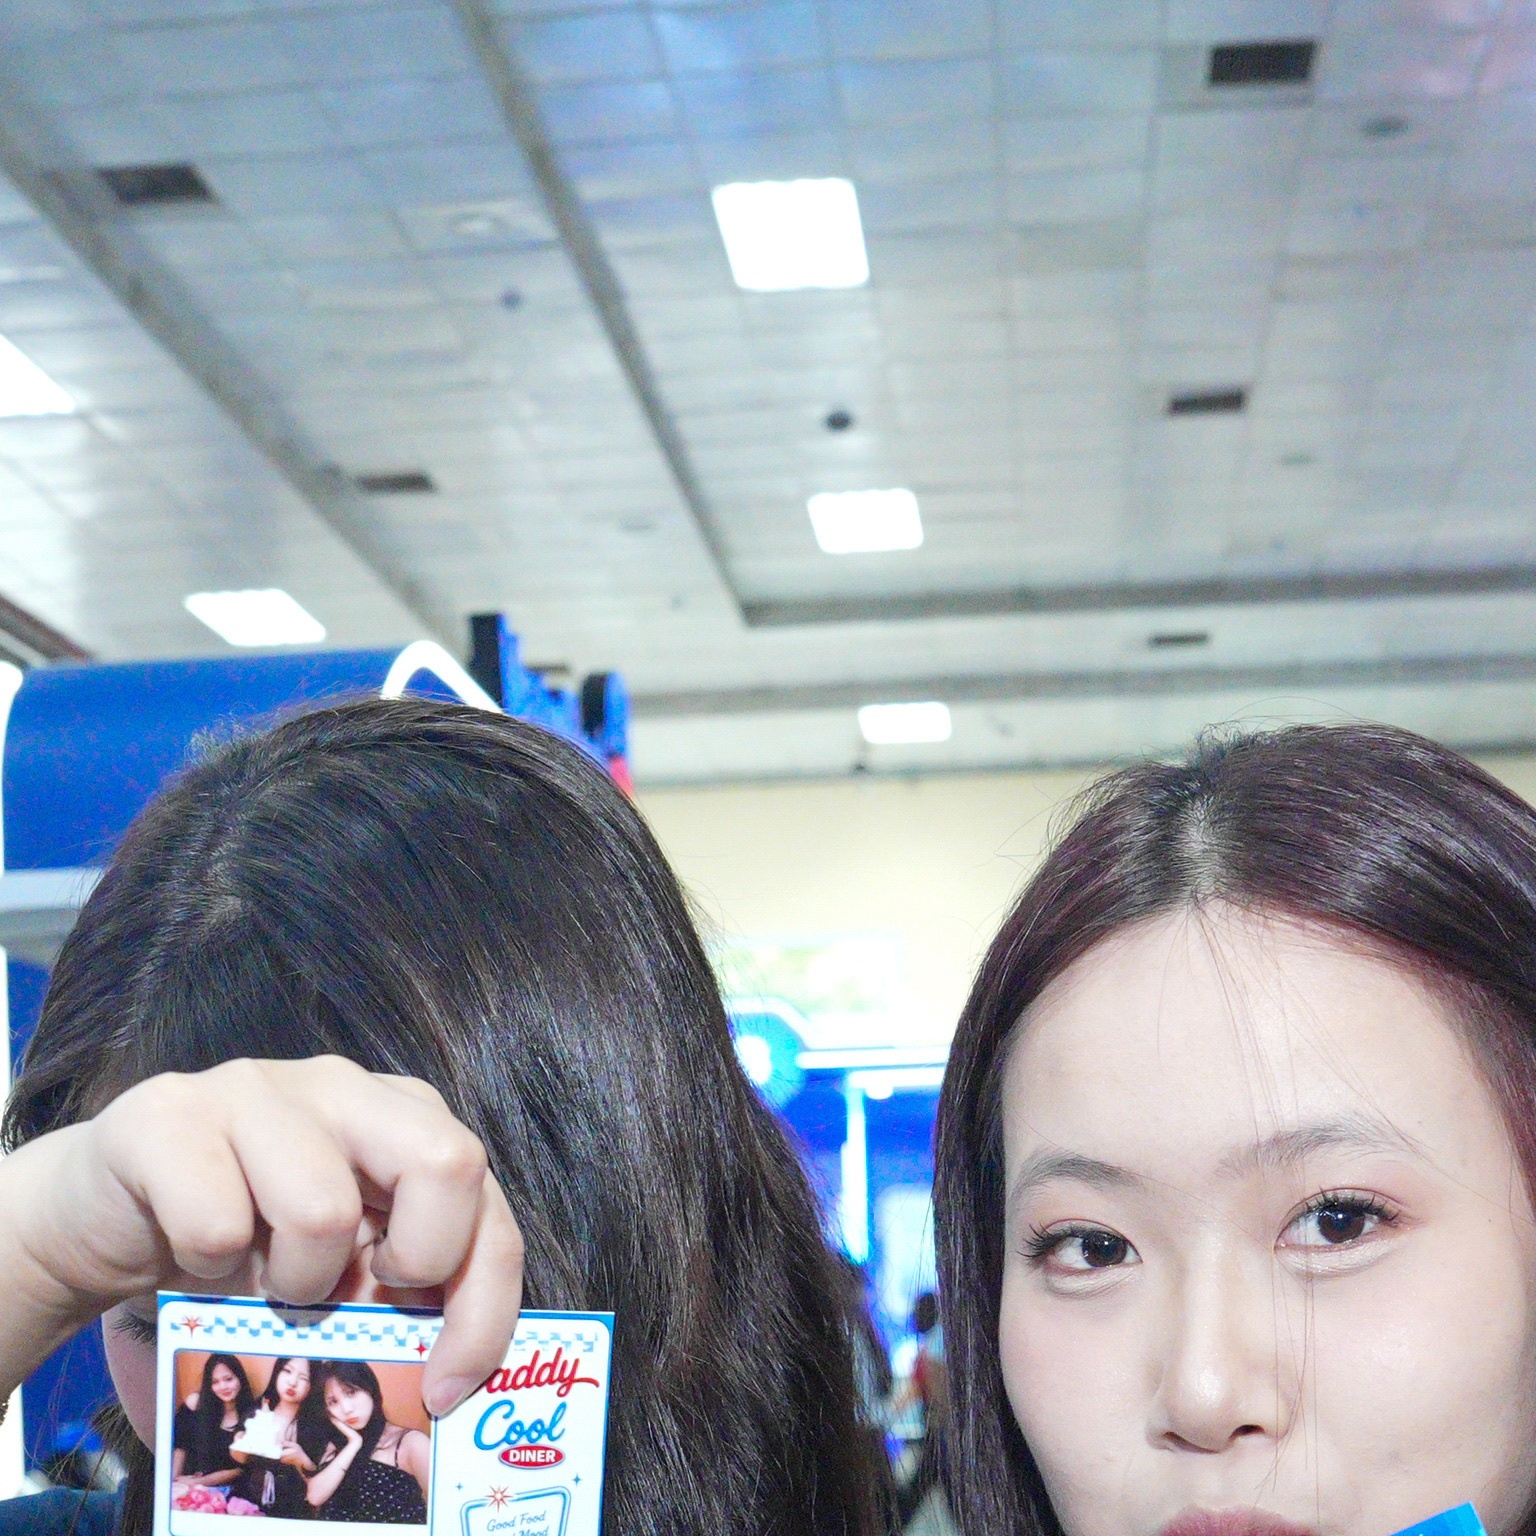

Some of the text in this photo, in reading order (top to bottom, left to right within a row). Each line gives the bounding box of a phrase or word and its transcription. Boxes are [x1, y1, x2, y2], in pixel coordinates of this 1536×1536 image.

[472, 1347, 600, 1397] addy
[474, 1399, 567, 1451] Cool
[509, 1449, 556, 1463] DINER
[486, 1510, 547, 1532] Good Food
